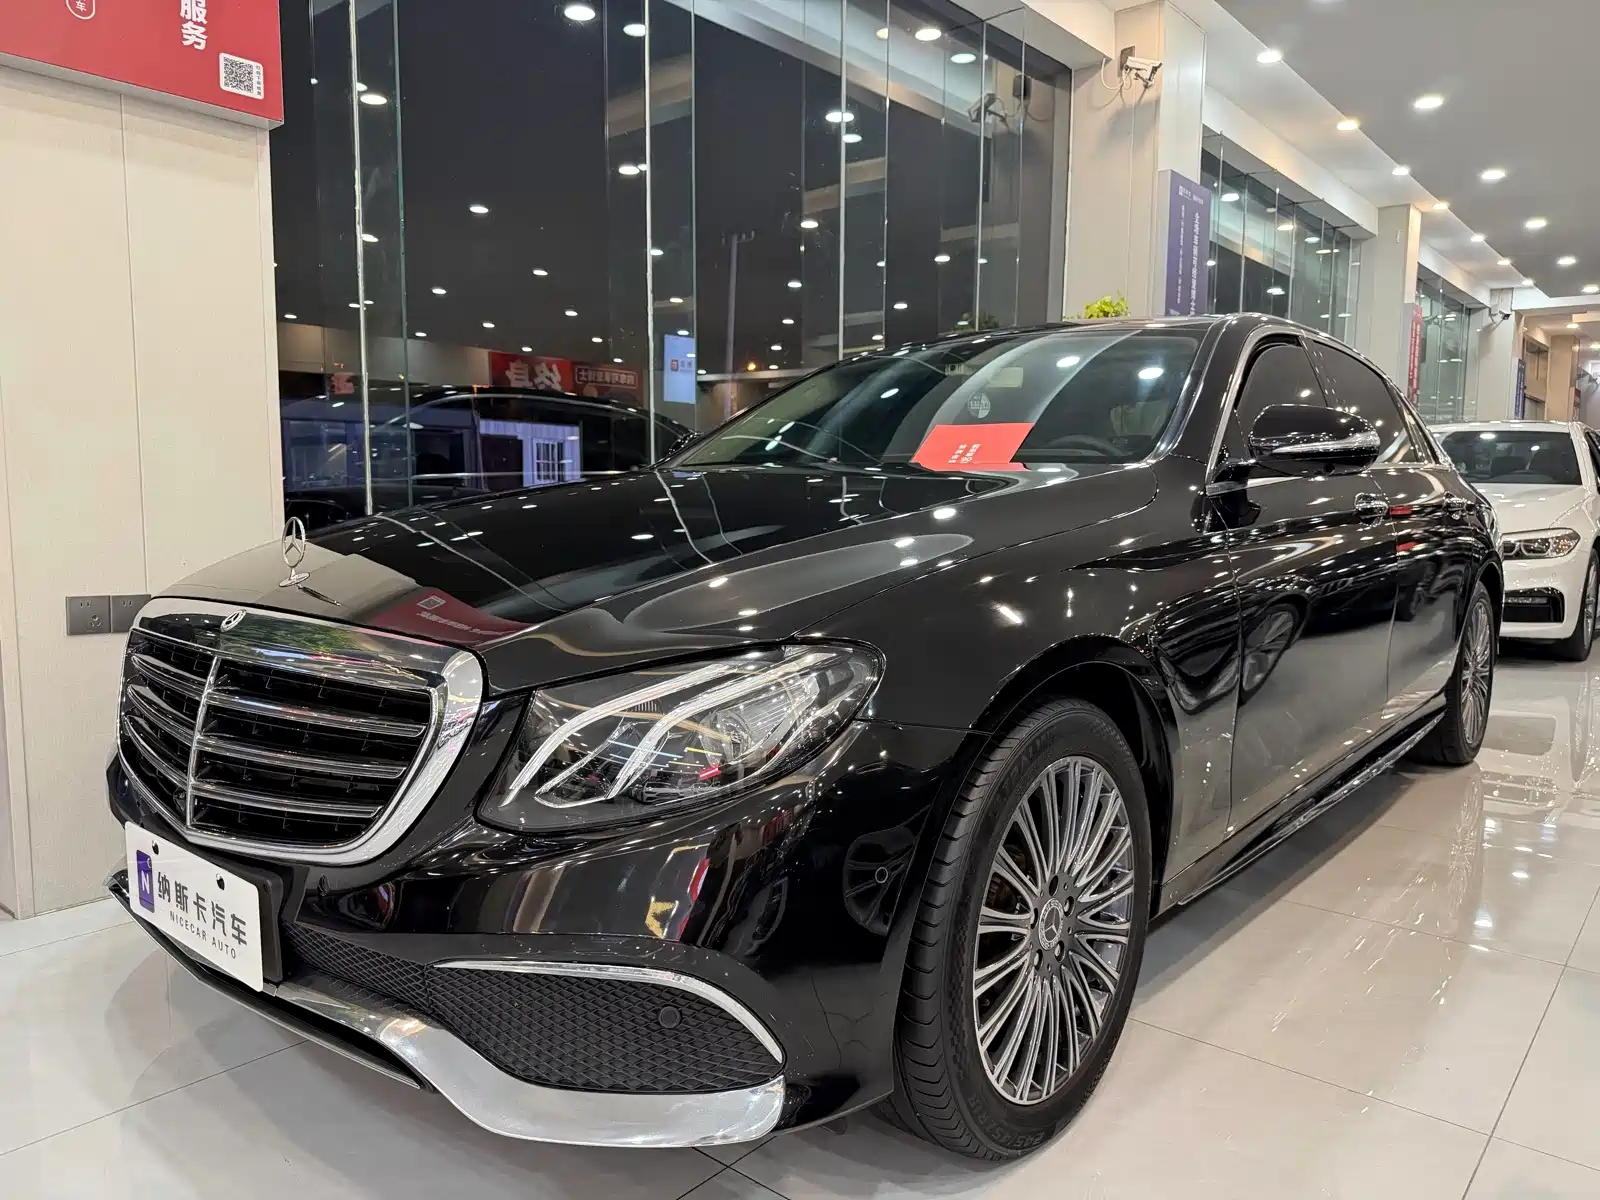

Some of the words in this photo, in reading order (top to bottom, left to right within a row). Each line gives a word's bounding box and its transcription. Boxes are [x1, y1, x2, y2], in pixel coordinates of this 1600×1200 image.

[180, 0, 208, 50] 服务
[157, 872, 248, 946] 纳斯卡汽车
[169, 910, 208, 941] NICECAR
[211, 936, 236, 959] AUTO
